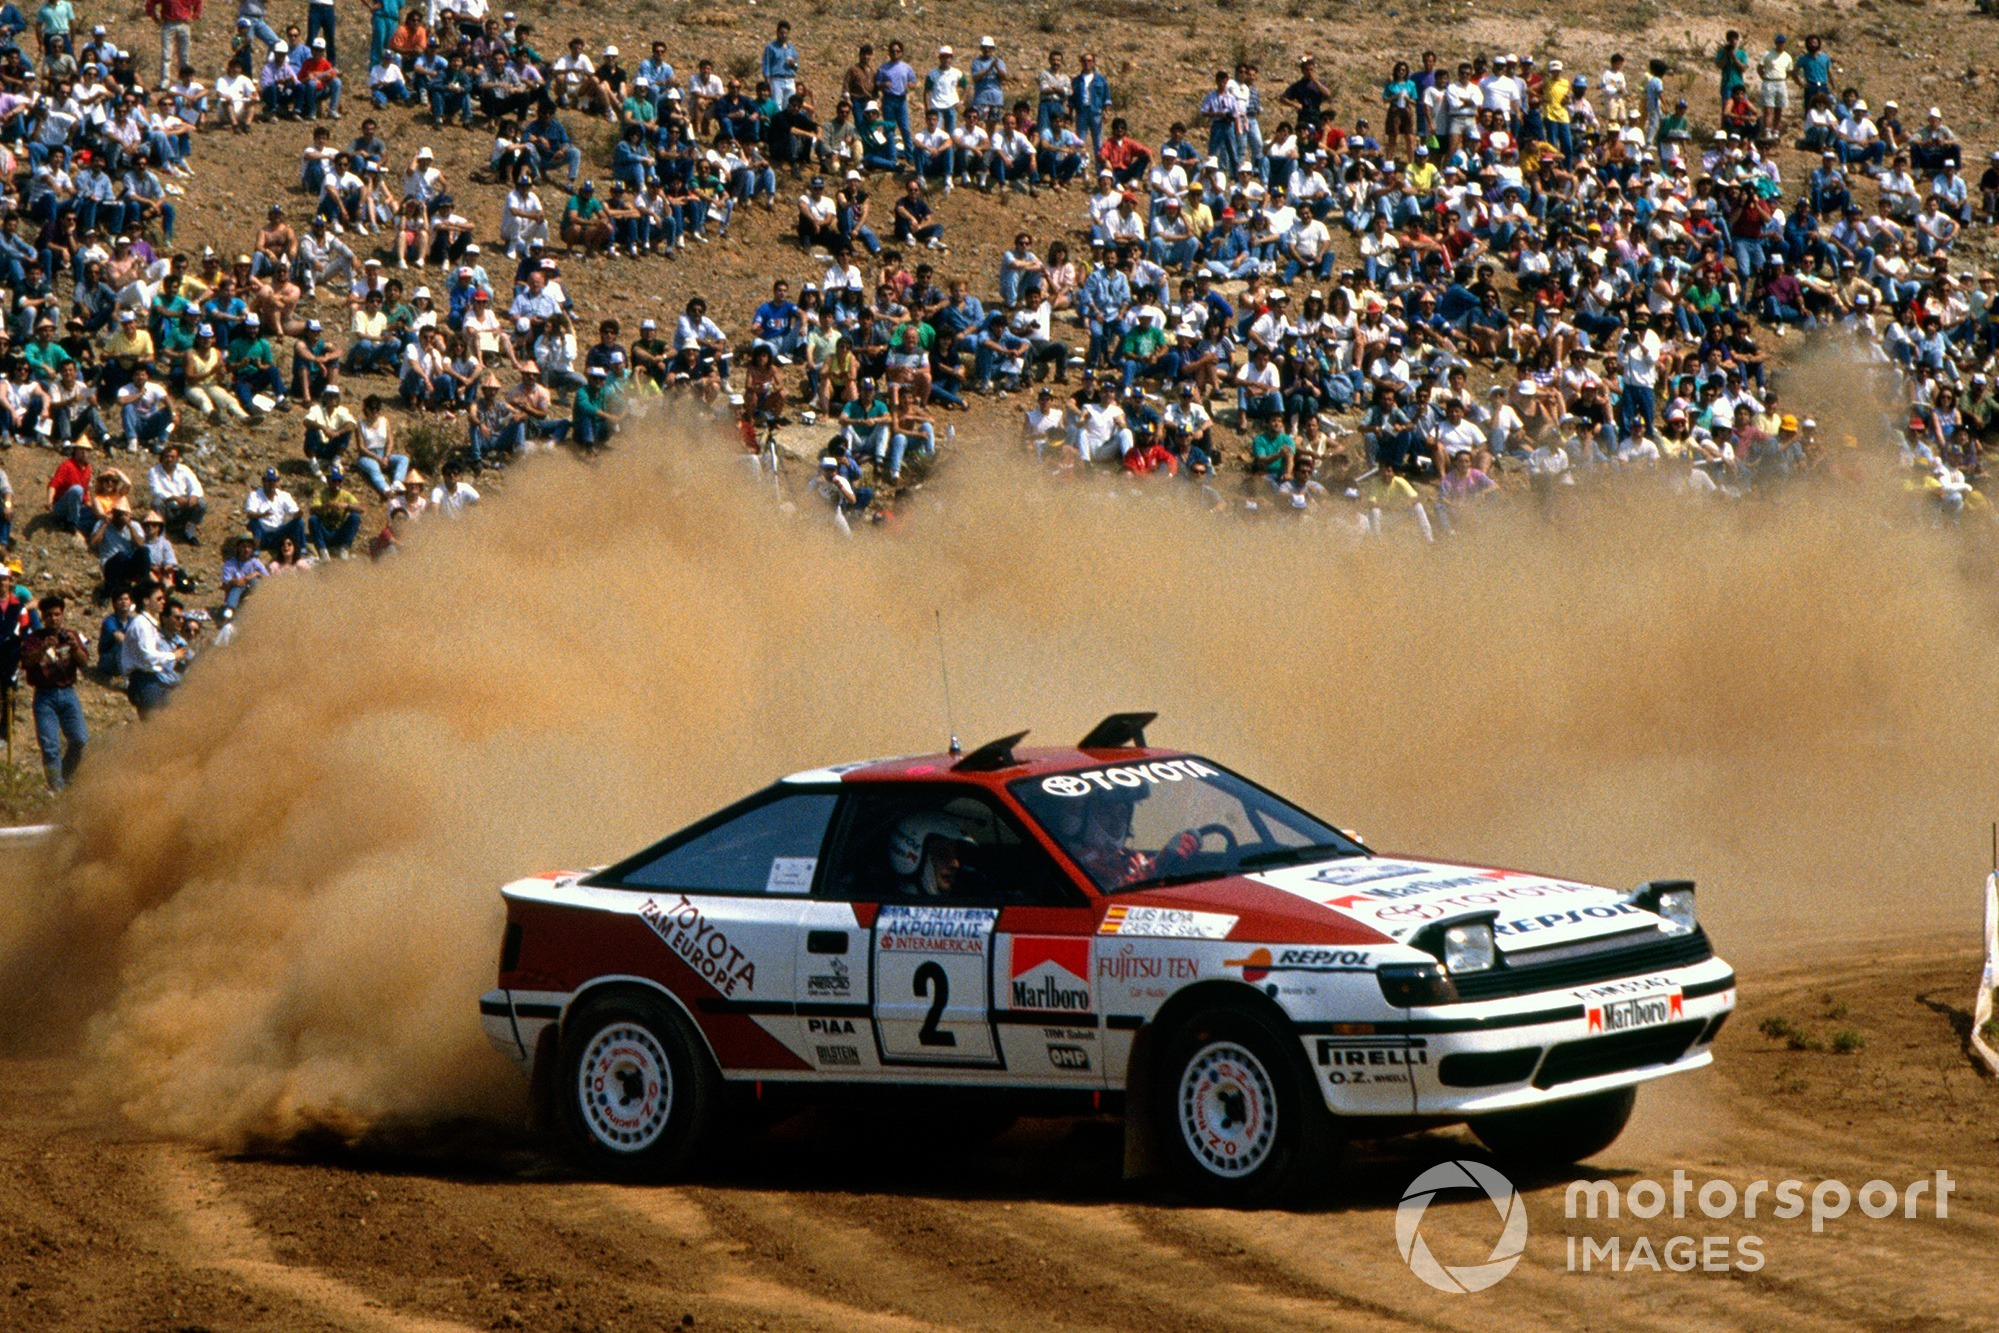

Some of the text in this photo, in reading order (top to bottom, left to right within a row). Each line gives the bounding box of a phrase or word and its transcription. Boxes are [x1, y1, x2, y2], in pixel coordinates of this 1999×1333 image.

[1081, 760, 1220, 790] TOYOTA
[1436, 883, 1586, 908] TOYOTA
[639, 898, 737, 996] TEAM EUROPE
[668, 894, 755, 991] TOYOTA
[896, 937, 983, 952] INTERAMERICAN
[1099, 951, 1199, 982] FUJITSU TEN
[1280, 950, 1371, 965] REPSOL
[913, 960, 957, 1047] 2
[1012, 975, 1090, 1010] Marlboro
[809, 1019, 856, 1034] PIAA
[1603, 1000, 1667, 1031] Marlboro
[816, 1045, 860, 1060] BILSTEIN
[1050, 1047, 1086, 1067] OMP
[1316, 1038, 1427, 1065] PIRELLI
